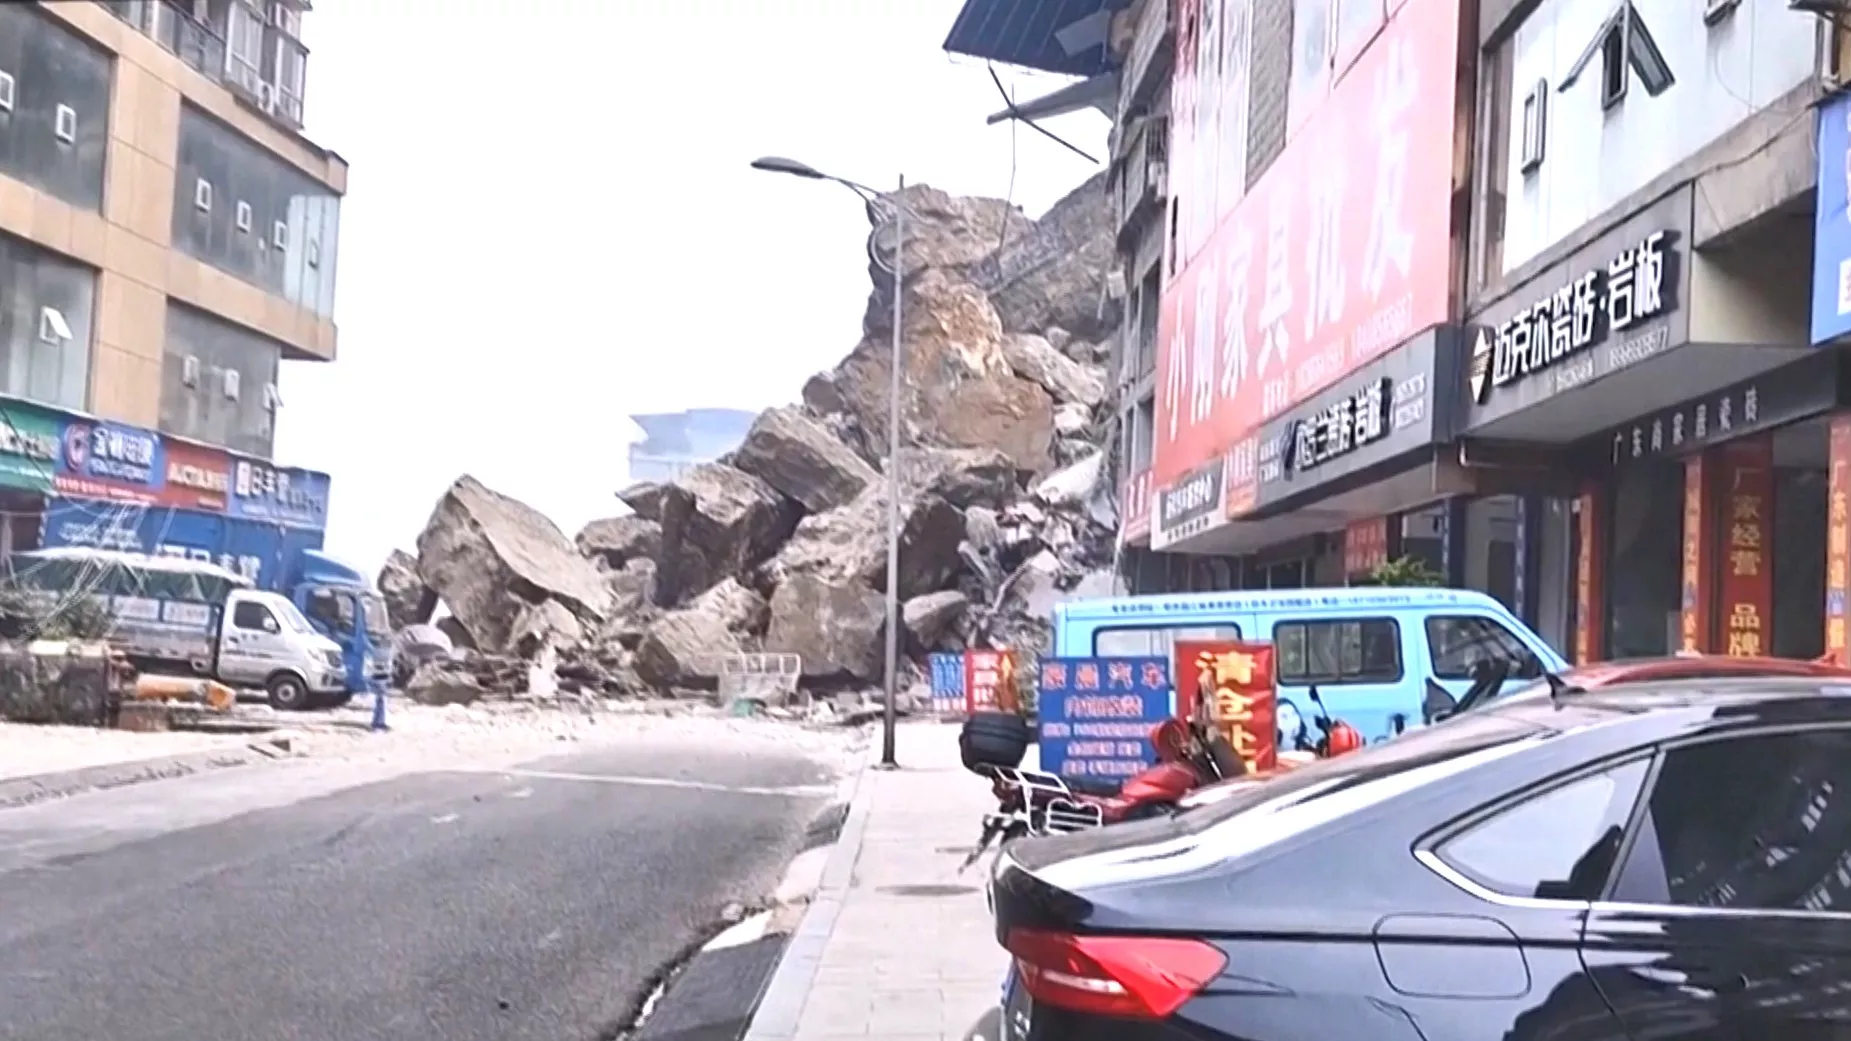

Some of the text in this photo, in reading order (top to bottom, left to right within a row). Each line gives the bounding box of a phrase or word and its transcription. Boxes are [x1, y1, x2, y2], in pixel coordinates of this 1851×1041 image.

[1492, 231, 1664, 386] 迈克尔瓷砖·岩板
[1728, 603, 1761, 658] 品牌
